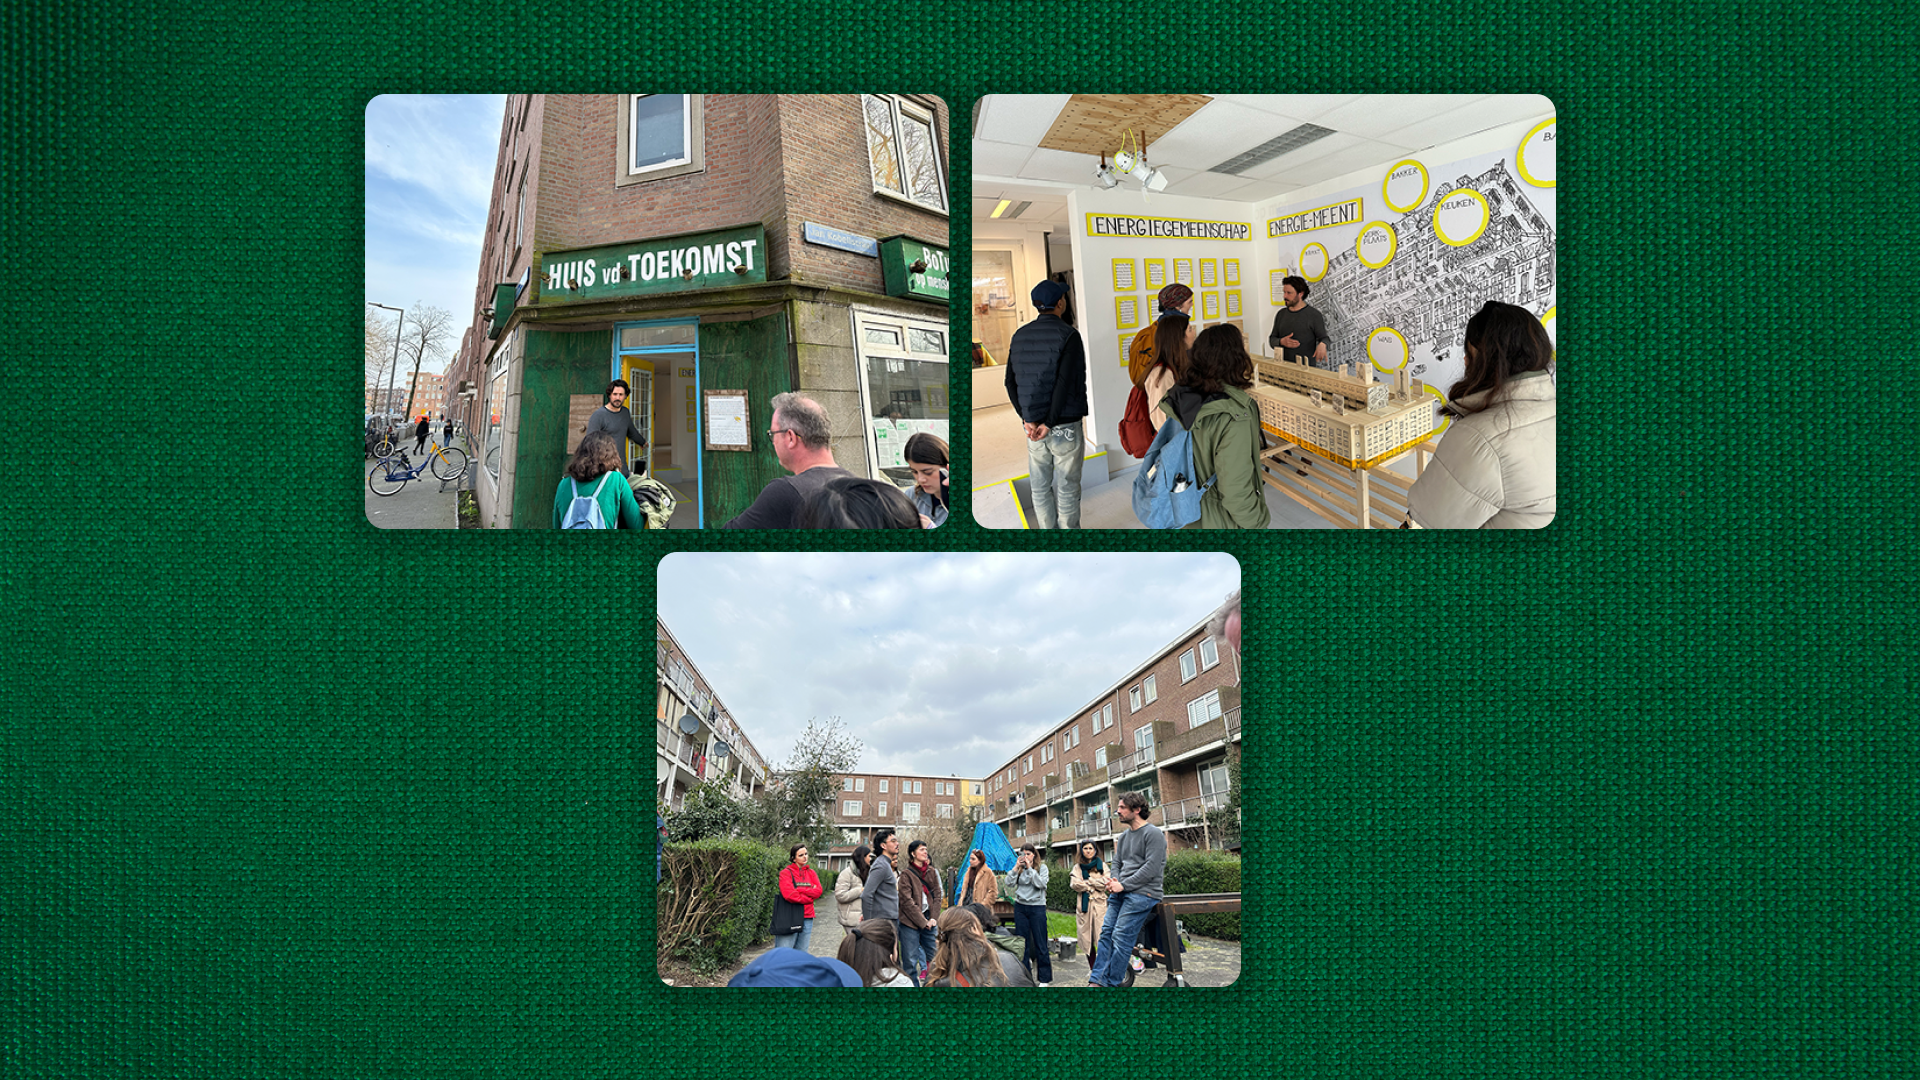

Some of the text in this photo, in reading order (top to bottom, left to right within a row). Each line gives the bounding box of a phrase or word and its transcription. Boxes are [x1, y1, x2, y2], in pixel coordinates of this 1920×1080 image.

[1440, 198, 1476, 211] KEUKEN
[1095, 216, 1248, 239] ENERGIEGEMEENSCHAP
[1269, 202, 1357, 237] ENERGIE-MEENT
[810, 228, 825, 238] Jan
[549, 239, 757, 290] HUIS vd TOEKOMST
